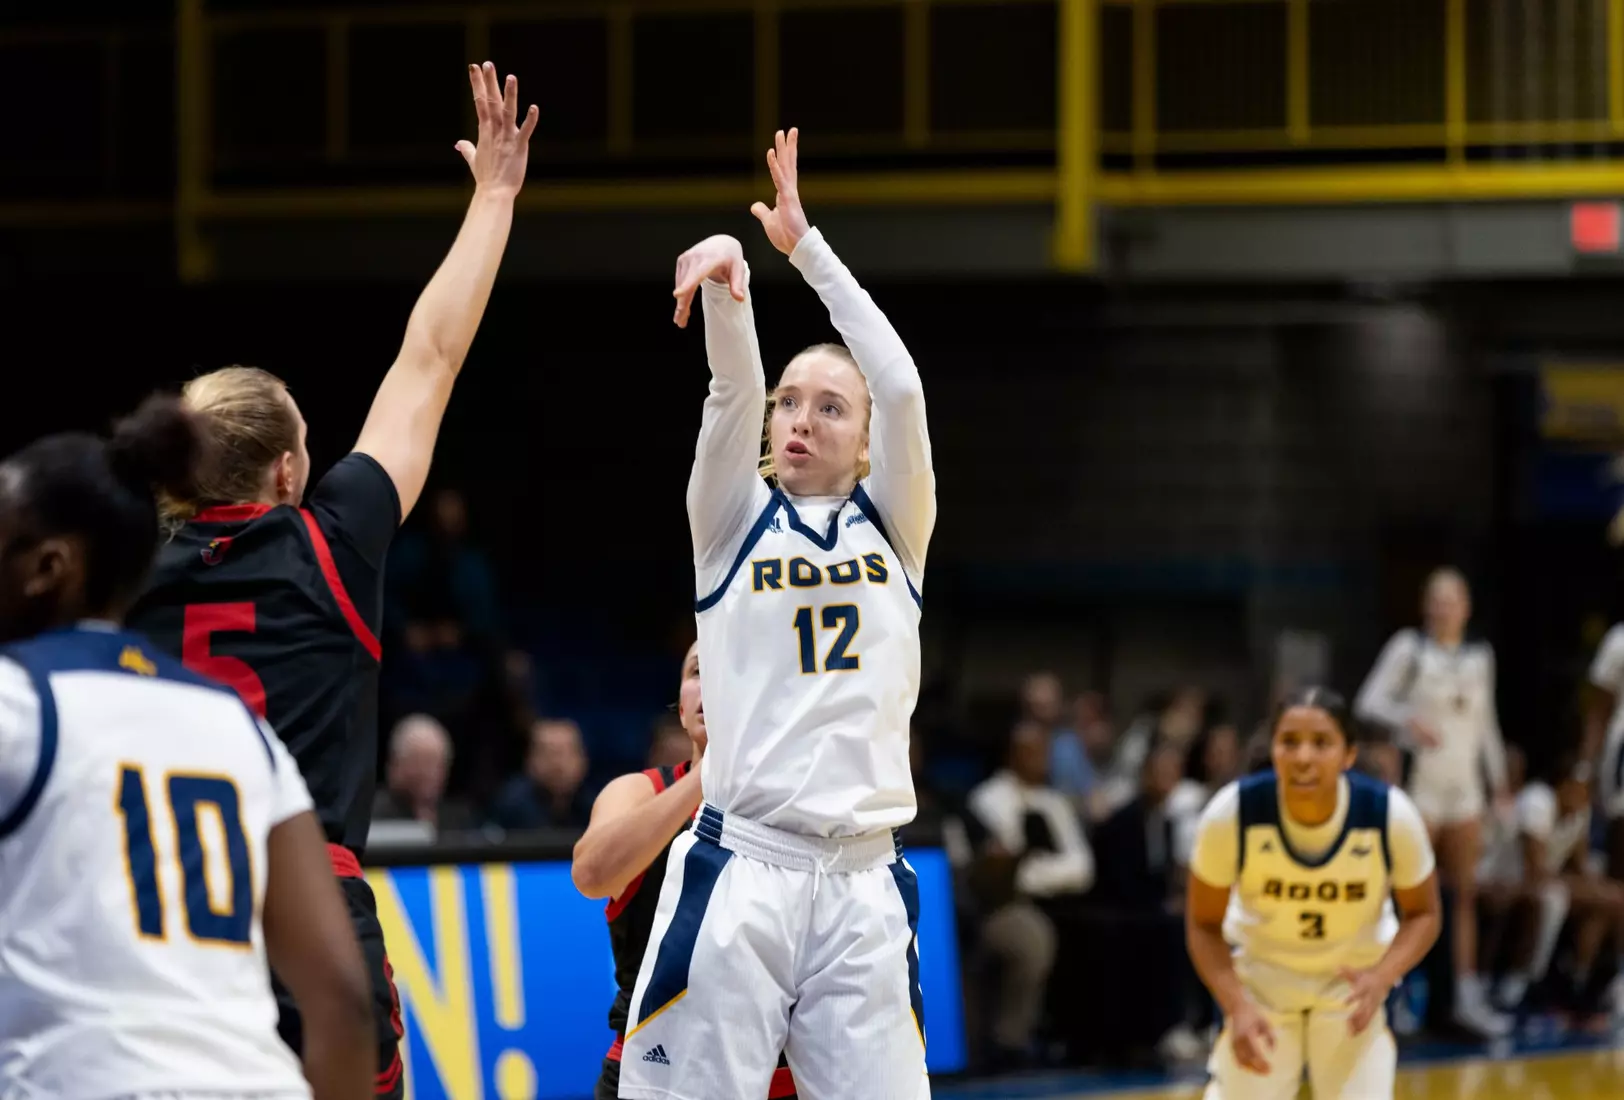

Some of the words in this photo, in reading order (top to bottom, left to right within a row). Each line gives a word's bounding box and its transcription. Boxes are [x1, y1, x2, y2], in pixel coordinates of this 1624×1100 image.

[752, 551, 889, 593] ROOS
[182, 602, 266, 719] 5
[792, 602, 861, 675] 12
[114, 762, 253, 950] 10
[1299, 911, 1325, 940] 3
[642, 1054, 671, 1066] adidas
